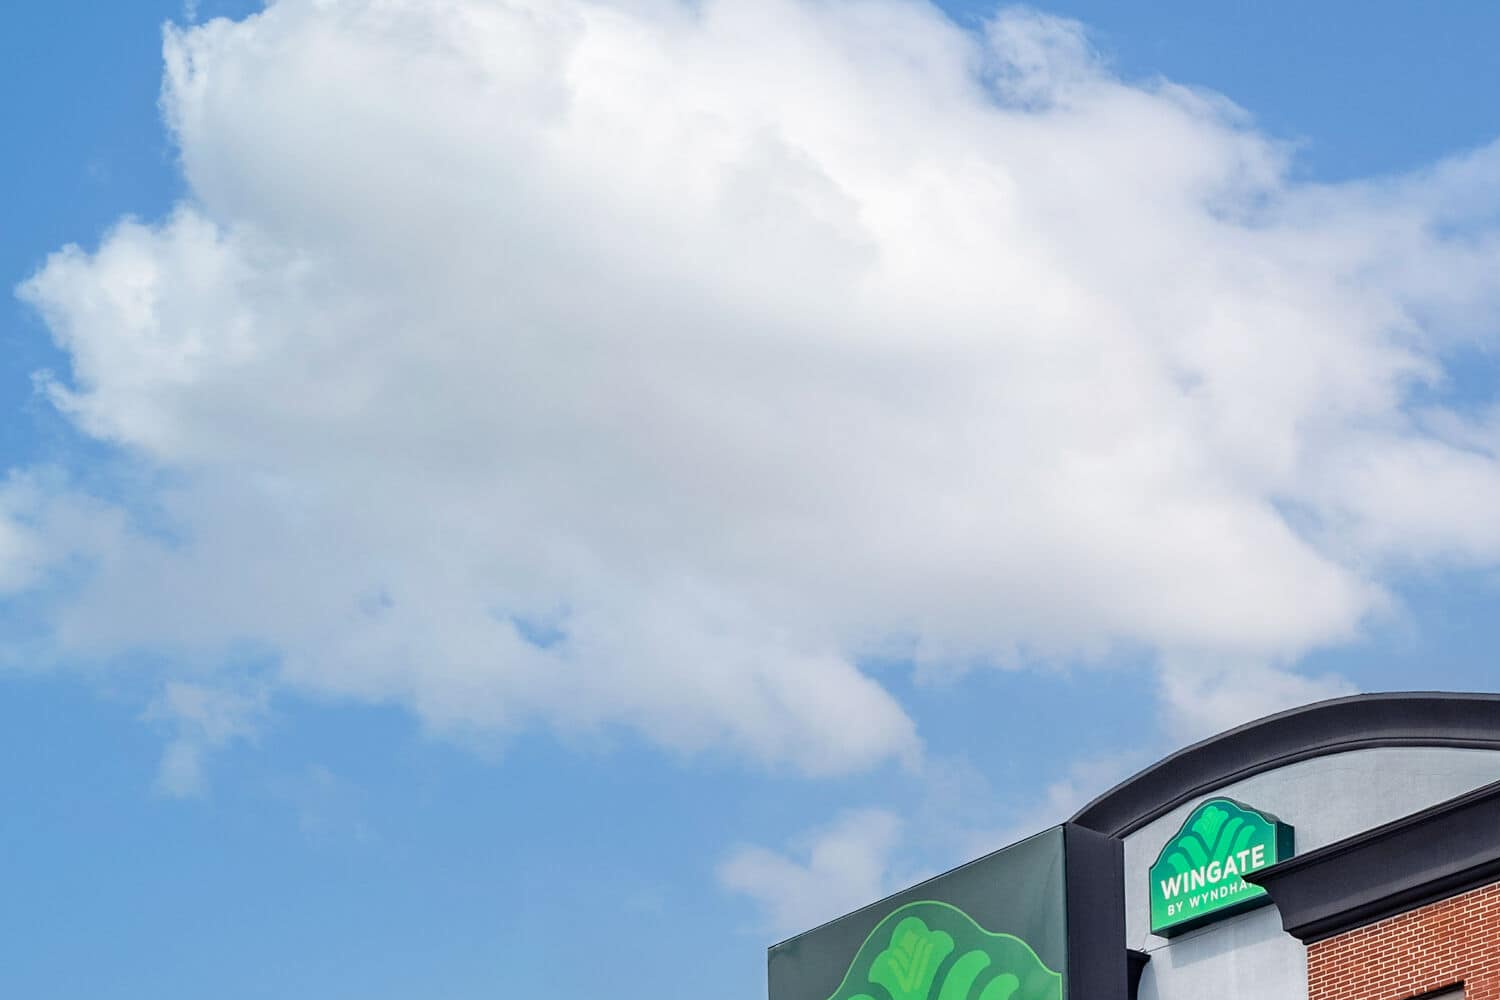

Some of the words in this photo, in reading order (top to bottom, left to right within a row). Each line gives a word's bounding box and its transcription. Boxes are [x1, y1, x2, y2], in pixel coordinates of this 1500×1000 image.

[1160, 844, 1265, 900] WINGATE
[1167, 900, 1184, 917] BY
[1189, 880, 1253, 908] WYNDHA
